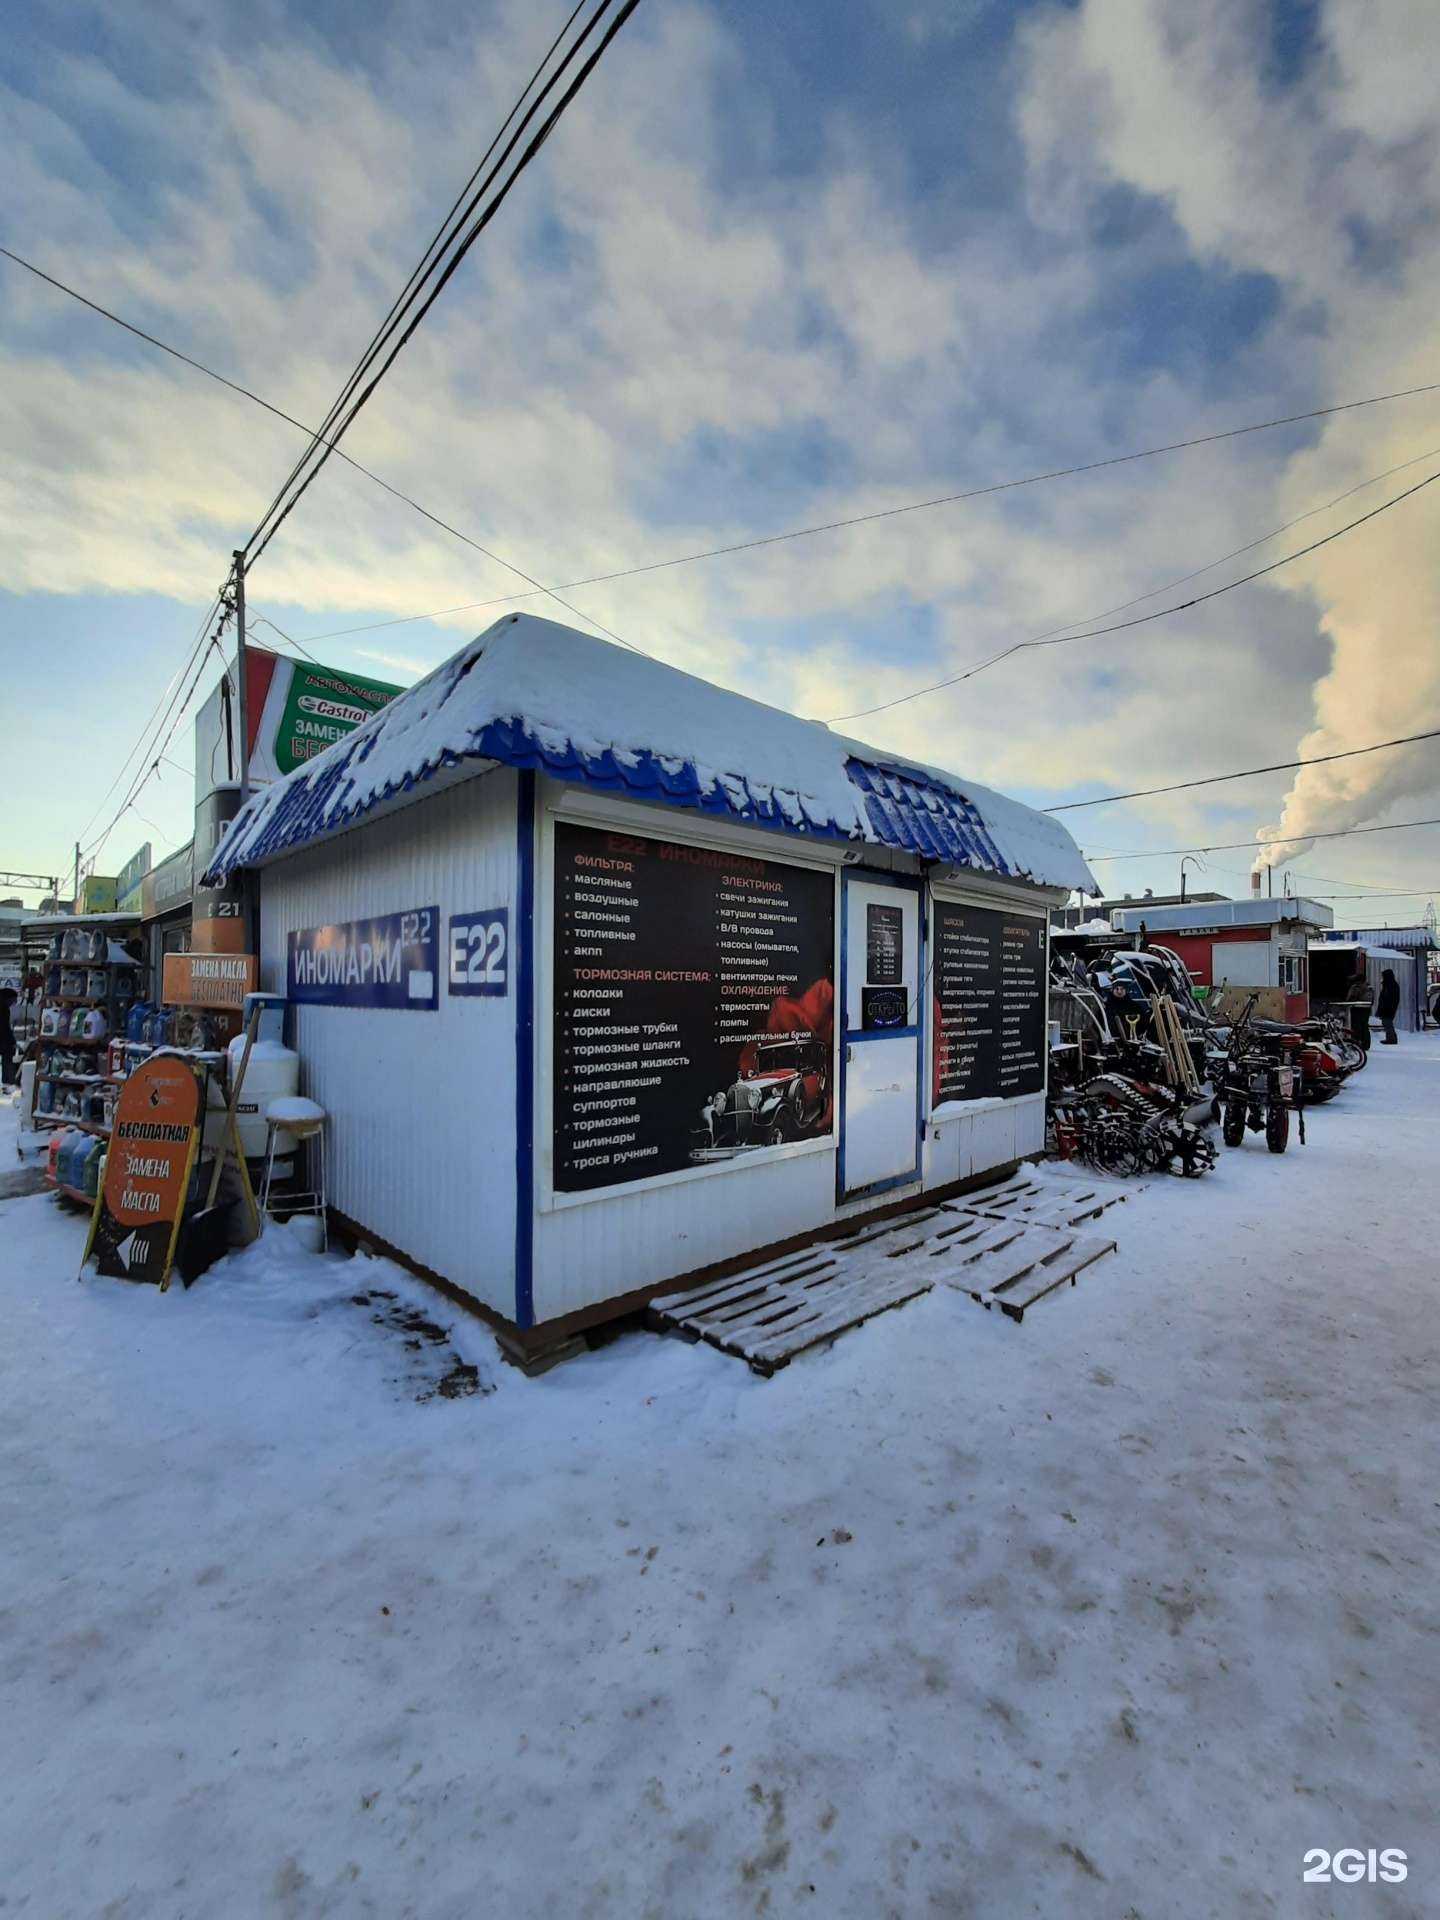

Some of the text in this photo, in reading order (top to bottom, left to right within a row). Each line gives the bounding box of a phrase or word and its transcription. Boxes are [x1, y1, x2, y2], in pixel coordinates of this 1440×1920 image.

[317, 701, 367, 723] Castrol
[574, 874, 632, 889] масляные
[574, 892, 639, 907] воздушные
[720, 892, 789, 907] свечи зажигания
[574, 910, 631, 924] салонные
[720, 908, 798, 923] катушки зажигания
[401, 911, 431, 947] Е22
[574, 928, 636, 941] топливные
[740, 925, 774, 936] провода
[450, 921, 506, 984] Е22
[574, 947, 603, 957] акпп
[721, 940, 752, 950] насосы
[294, 938, 402, 984] ИНОМАРКИ
[720, 956, 769, 968] топливные)
[191, 959, 247, 980] ЗАМЕНА МАСЛА
[574, 968, 712, 983] ТОРМОЗНАЯ СИСТЕМА:
[721, 973, 798, 983] вентиляторы печки
[573, 988, 623, 999] колодки
[573, 1007, 611, 1018] диски
[720, 1002, 770, 1013] термостаты
[573, 1022, 678, 1038] тормозные трубки
[720, 1018, 749, 1028] помпы
[719, 1029, 812, 1044] расширительные бачки
[573, 1039, 681, 1056] тормозные шланги
[573, 1055, 690, 1075] тормозная жидкость
[573, 1096, 636, 1113] суппортов
[573, 1114, 640, 1131] тормозные
[118, 1121, 191, 1142] БЕСПЛАТНАЯ
[573, 1132, 635, 1150] цилиндры
[573, 1145, 659, 1170] троса ручника
[125, 1156, 171, 1178] ЗАМЕНА
[121, 1190, 161, 1213] МАСЛА
